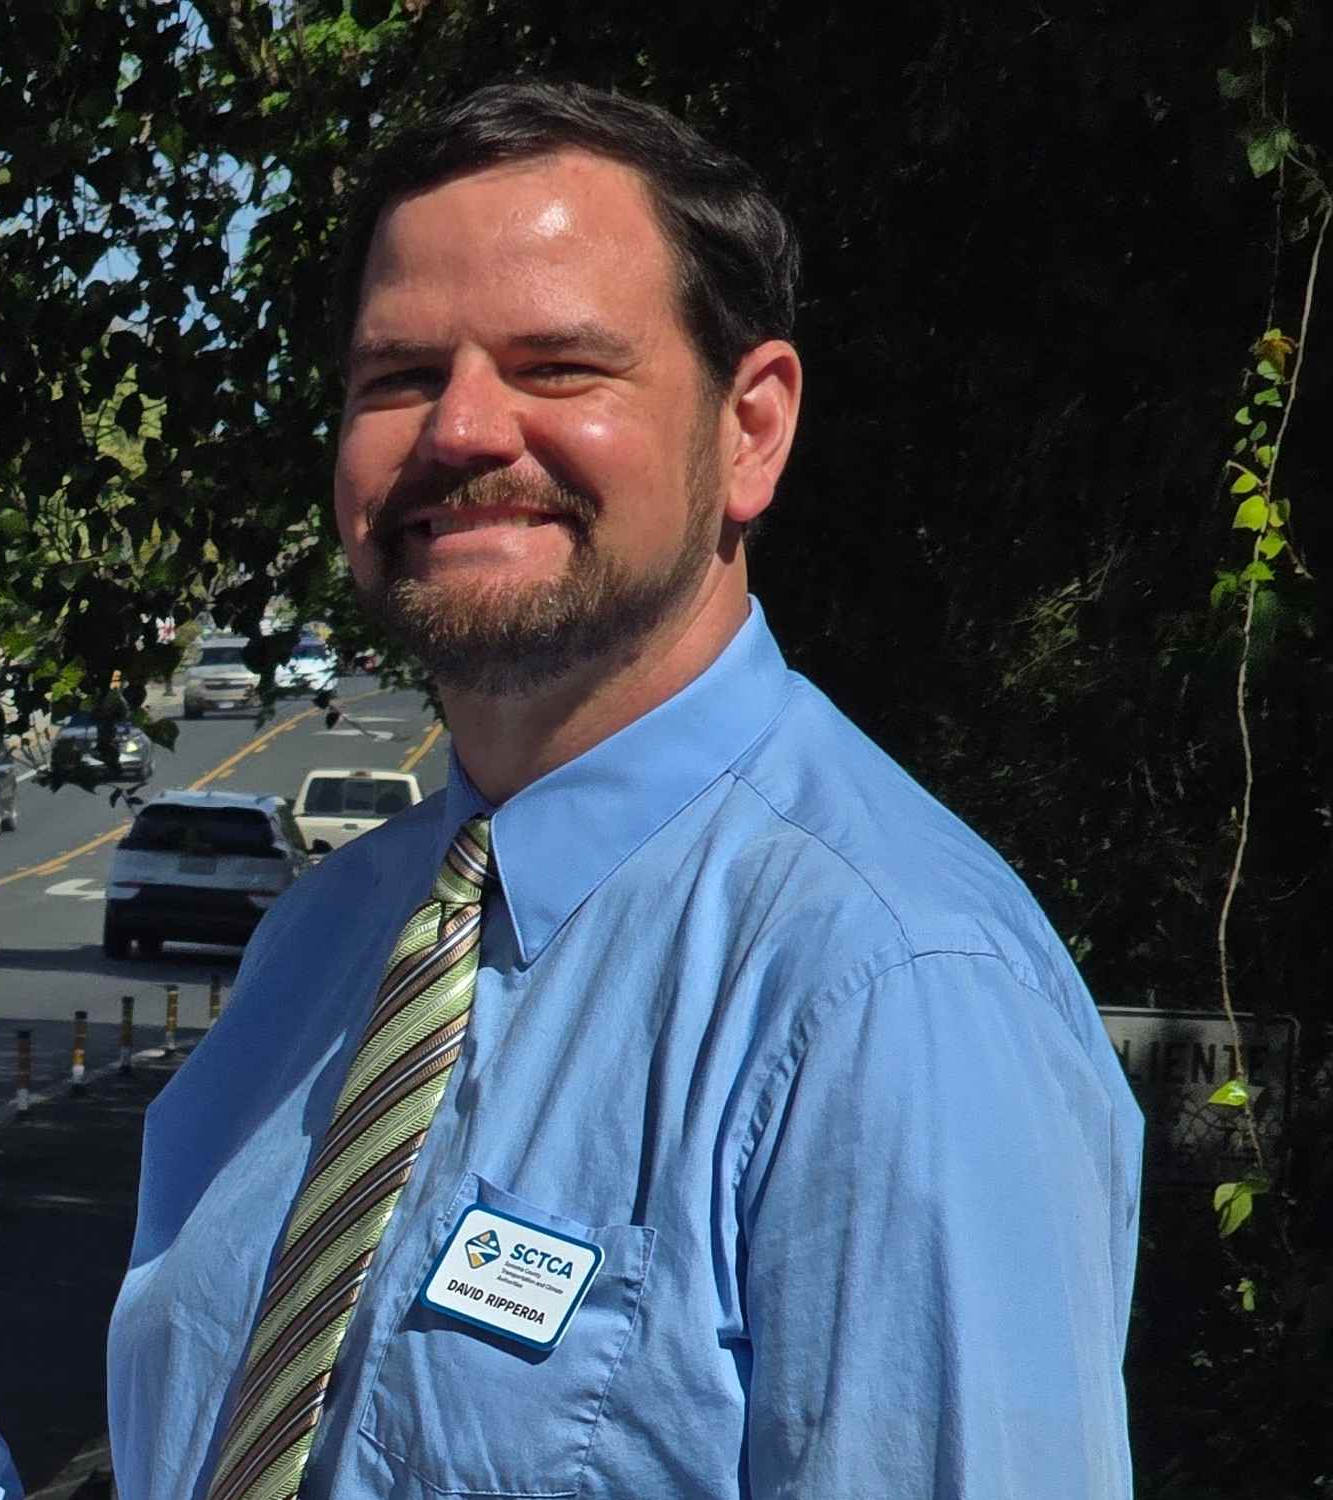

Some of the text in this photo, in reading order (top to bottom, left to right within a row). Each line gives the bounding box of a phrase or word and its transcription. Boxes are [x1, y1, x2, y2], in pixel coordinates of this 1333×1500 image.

[510, 1243, 574, 1280] SCTCA
[447, 1279, 546, 1325] DAVID RIPPERDA
